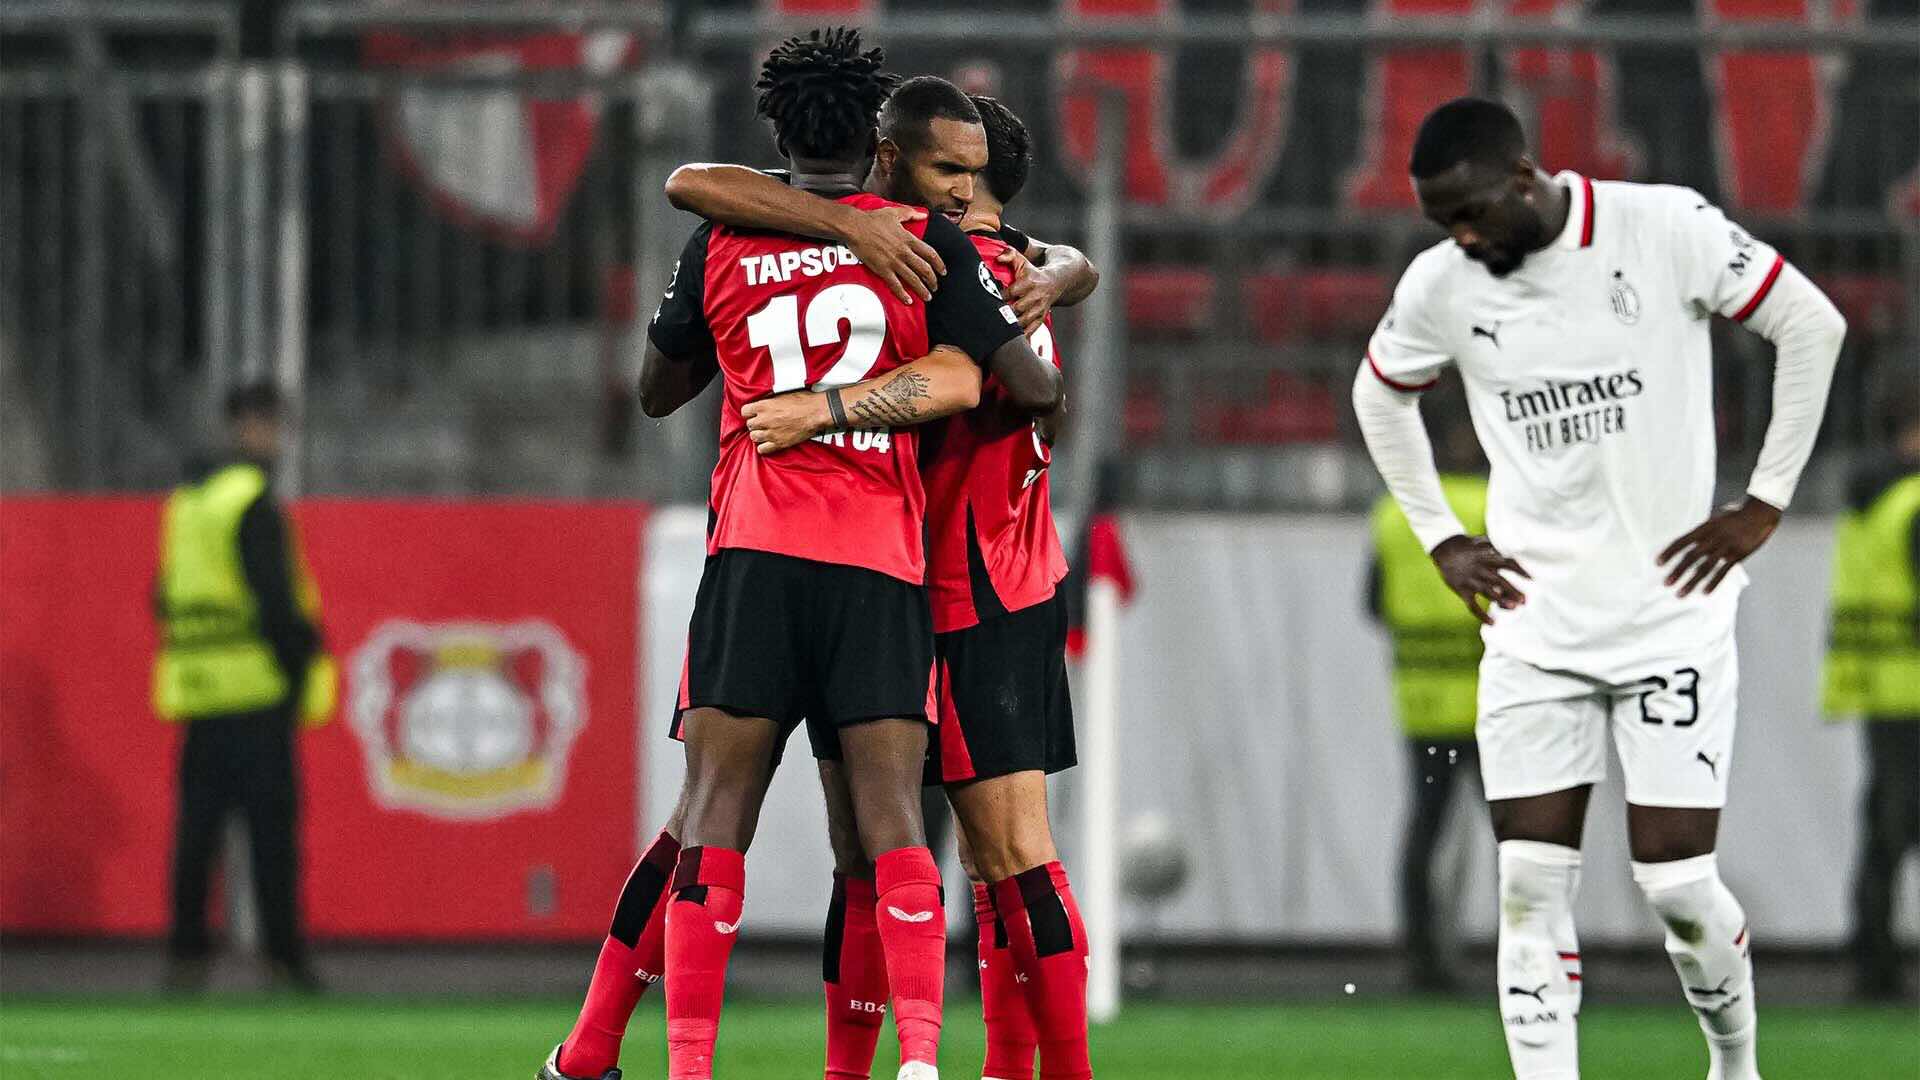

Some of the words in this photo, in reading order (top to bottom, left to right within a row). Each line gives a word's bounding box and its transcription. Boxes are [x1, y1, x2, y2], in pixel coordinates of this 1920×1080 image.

[740, 245, 863, 286] TAPSOB
[746, 283, 887, 394] 12
[1499, 369, 1643, 422] Emirates
[1525, 421, 1553, 453] FLY
[1559, 404, 1626, 445] BETTER
[1639, 667, 1700, 727] 23
